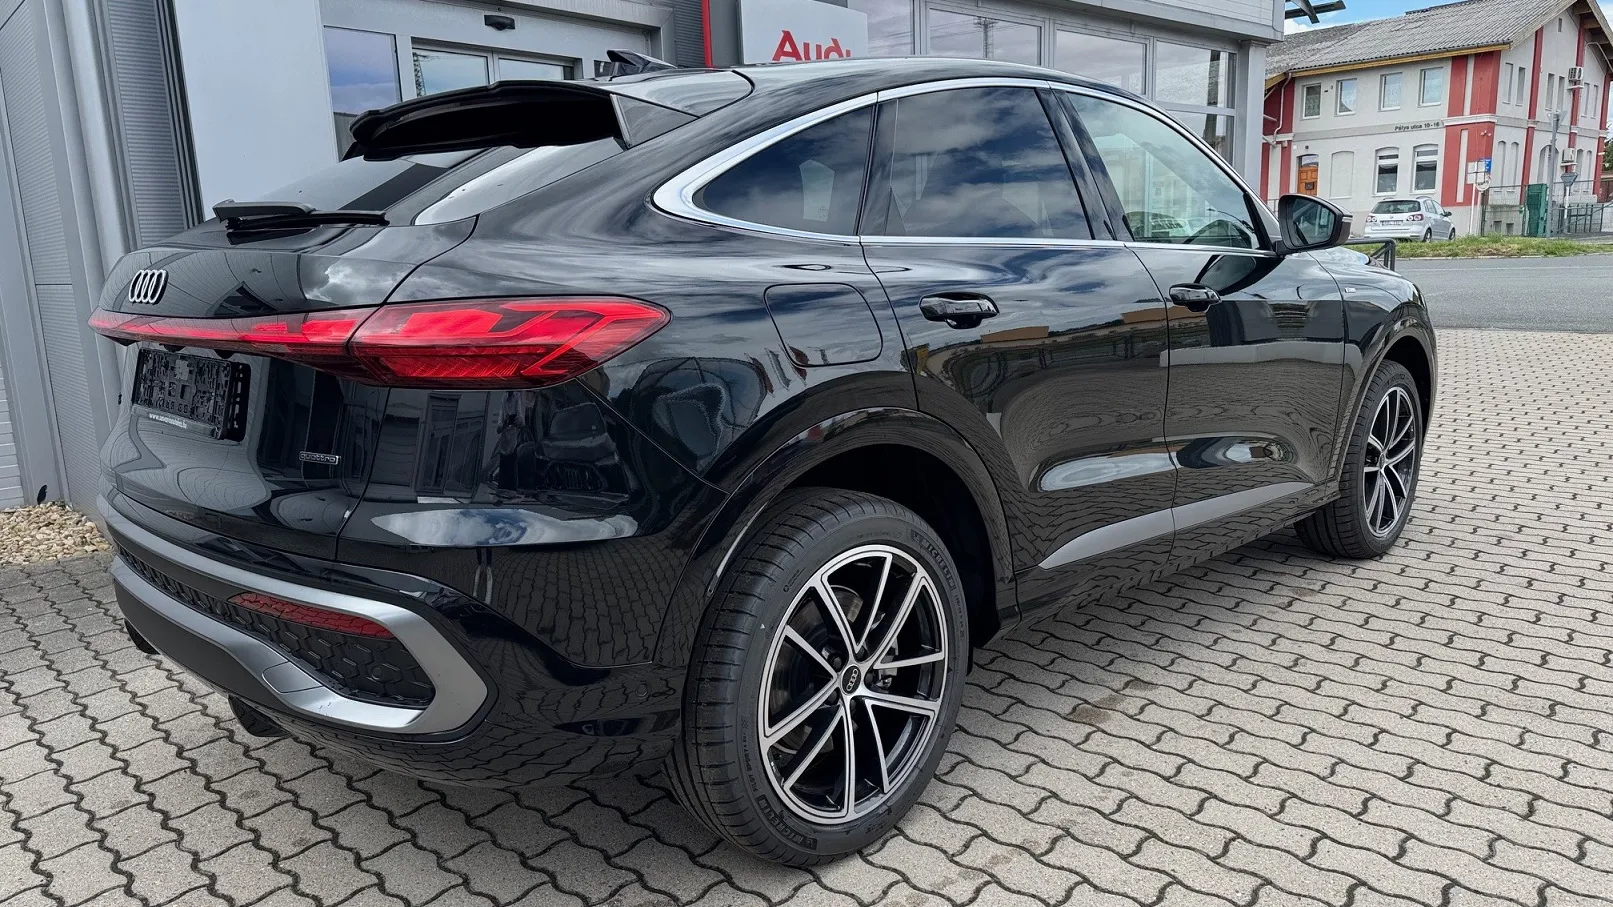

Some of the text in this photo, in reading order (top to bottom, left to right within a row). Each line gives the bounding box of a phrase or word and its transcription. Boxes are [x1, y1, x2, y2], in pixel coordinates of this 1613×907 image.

[772, 29, 851, 61] Aud
[299, 452, 338, 464] quattro
[758, 799, 805, 843] MICHELIN
